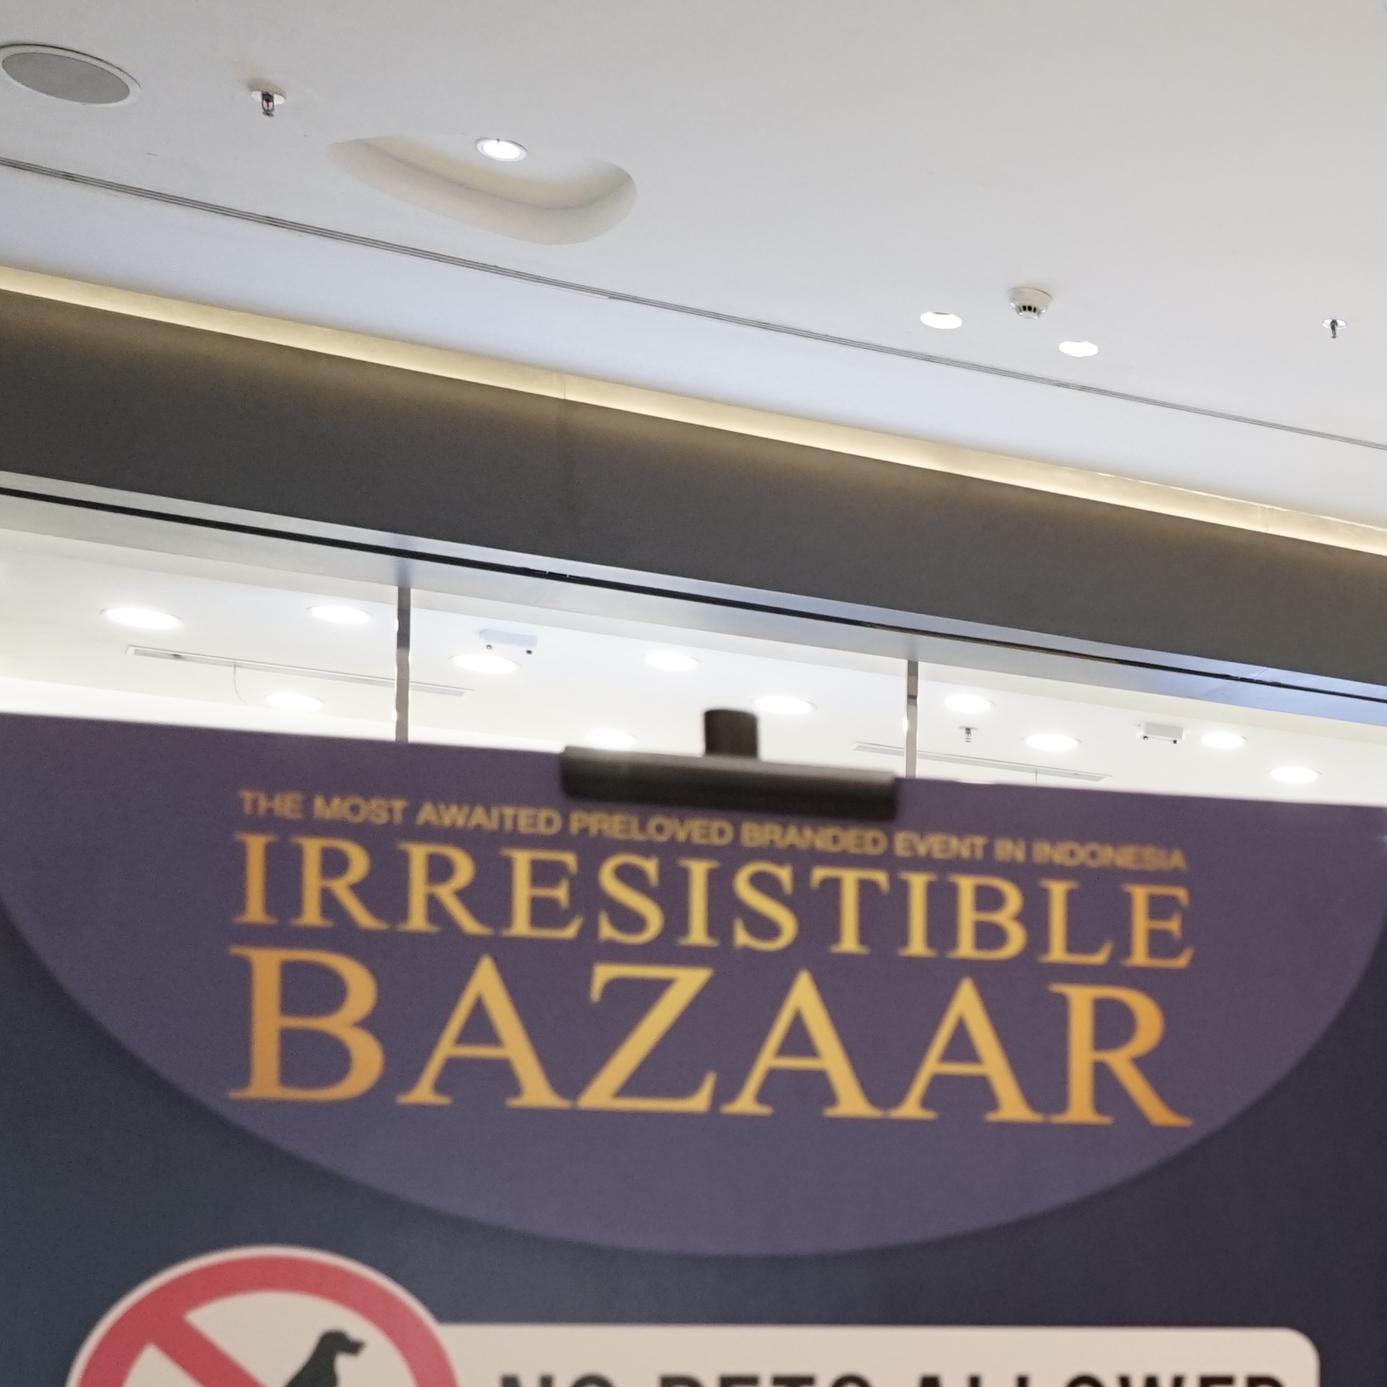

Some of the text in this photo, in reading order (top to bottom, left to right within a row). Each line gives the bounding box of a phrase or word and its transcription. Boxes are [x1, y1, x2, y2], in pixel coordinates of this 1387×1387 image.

[239, 790, 1187, 872] THE MOST AWAITED PRELOVED BRANDED EVENT IN INDONESIA
[233, 832, 1195, 969] IRRESISTIBLE
[229, 946, 1193, 1128] BAZAAR
